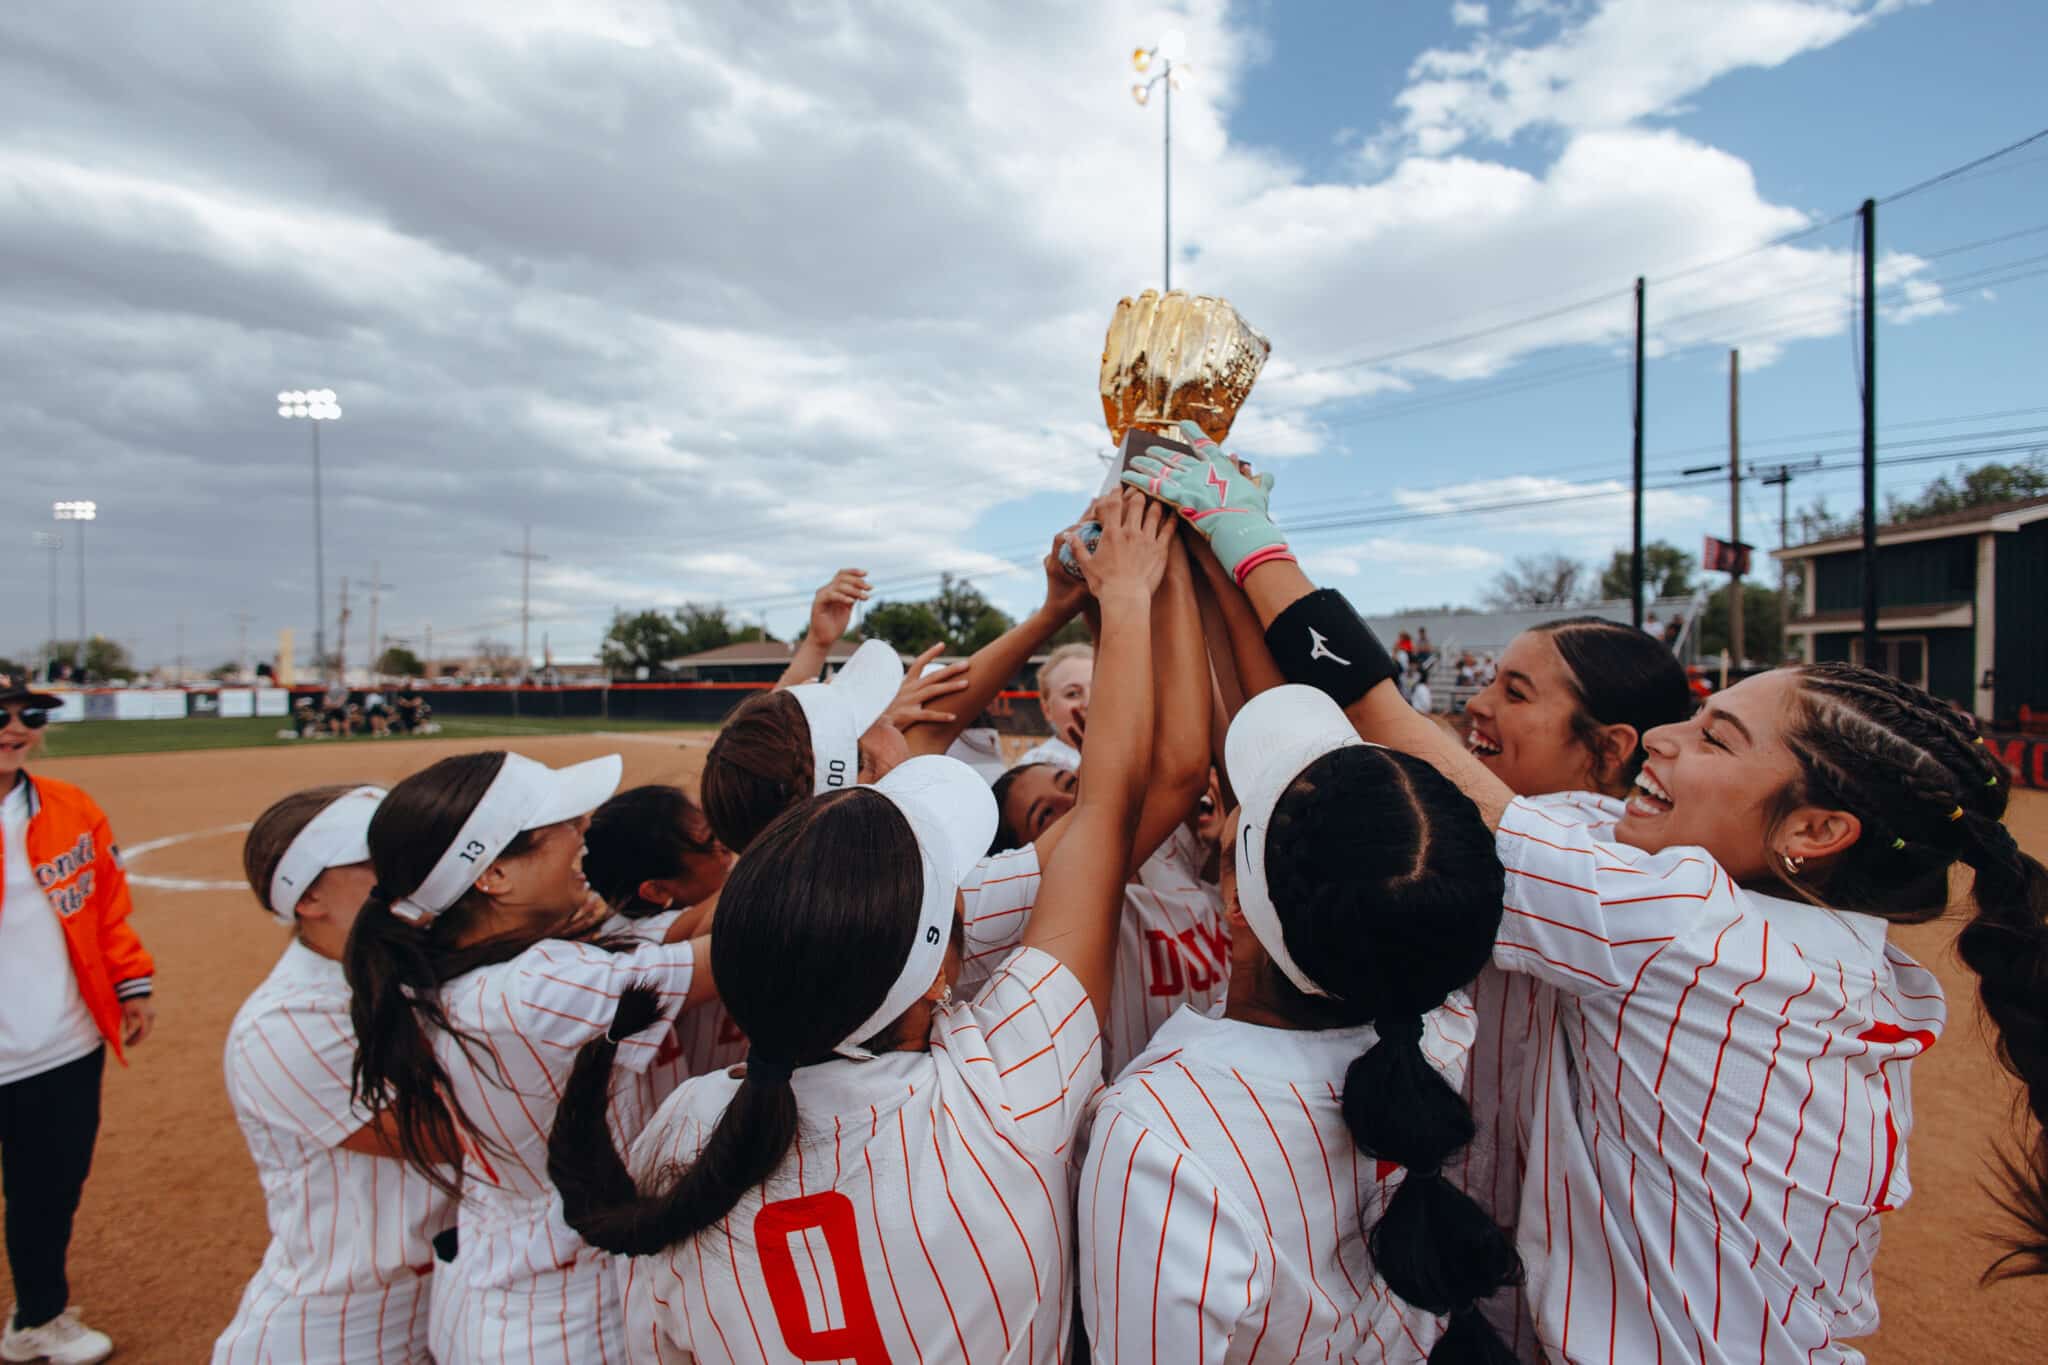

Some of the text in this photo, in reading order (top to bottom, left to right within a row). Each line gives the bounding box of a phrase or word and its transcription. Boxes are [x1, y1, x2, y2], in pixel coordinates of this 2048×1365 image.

[827, 759, 846, 787] 00
[459, 839, 486, 865] 13
[278, 875, 294, 887] 1
